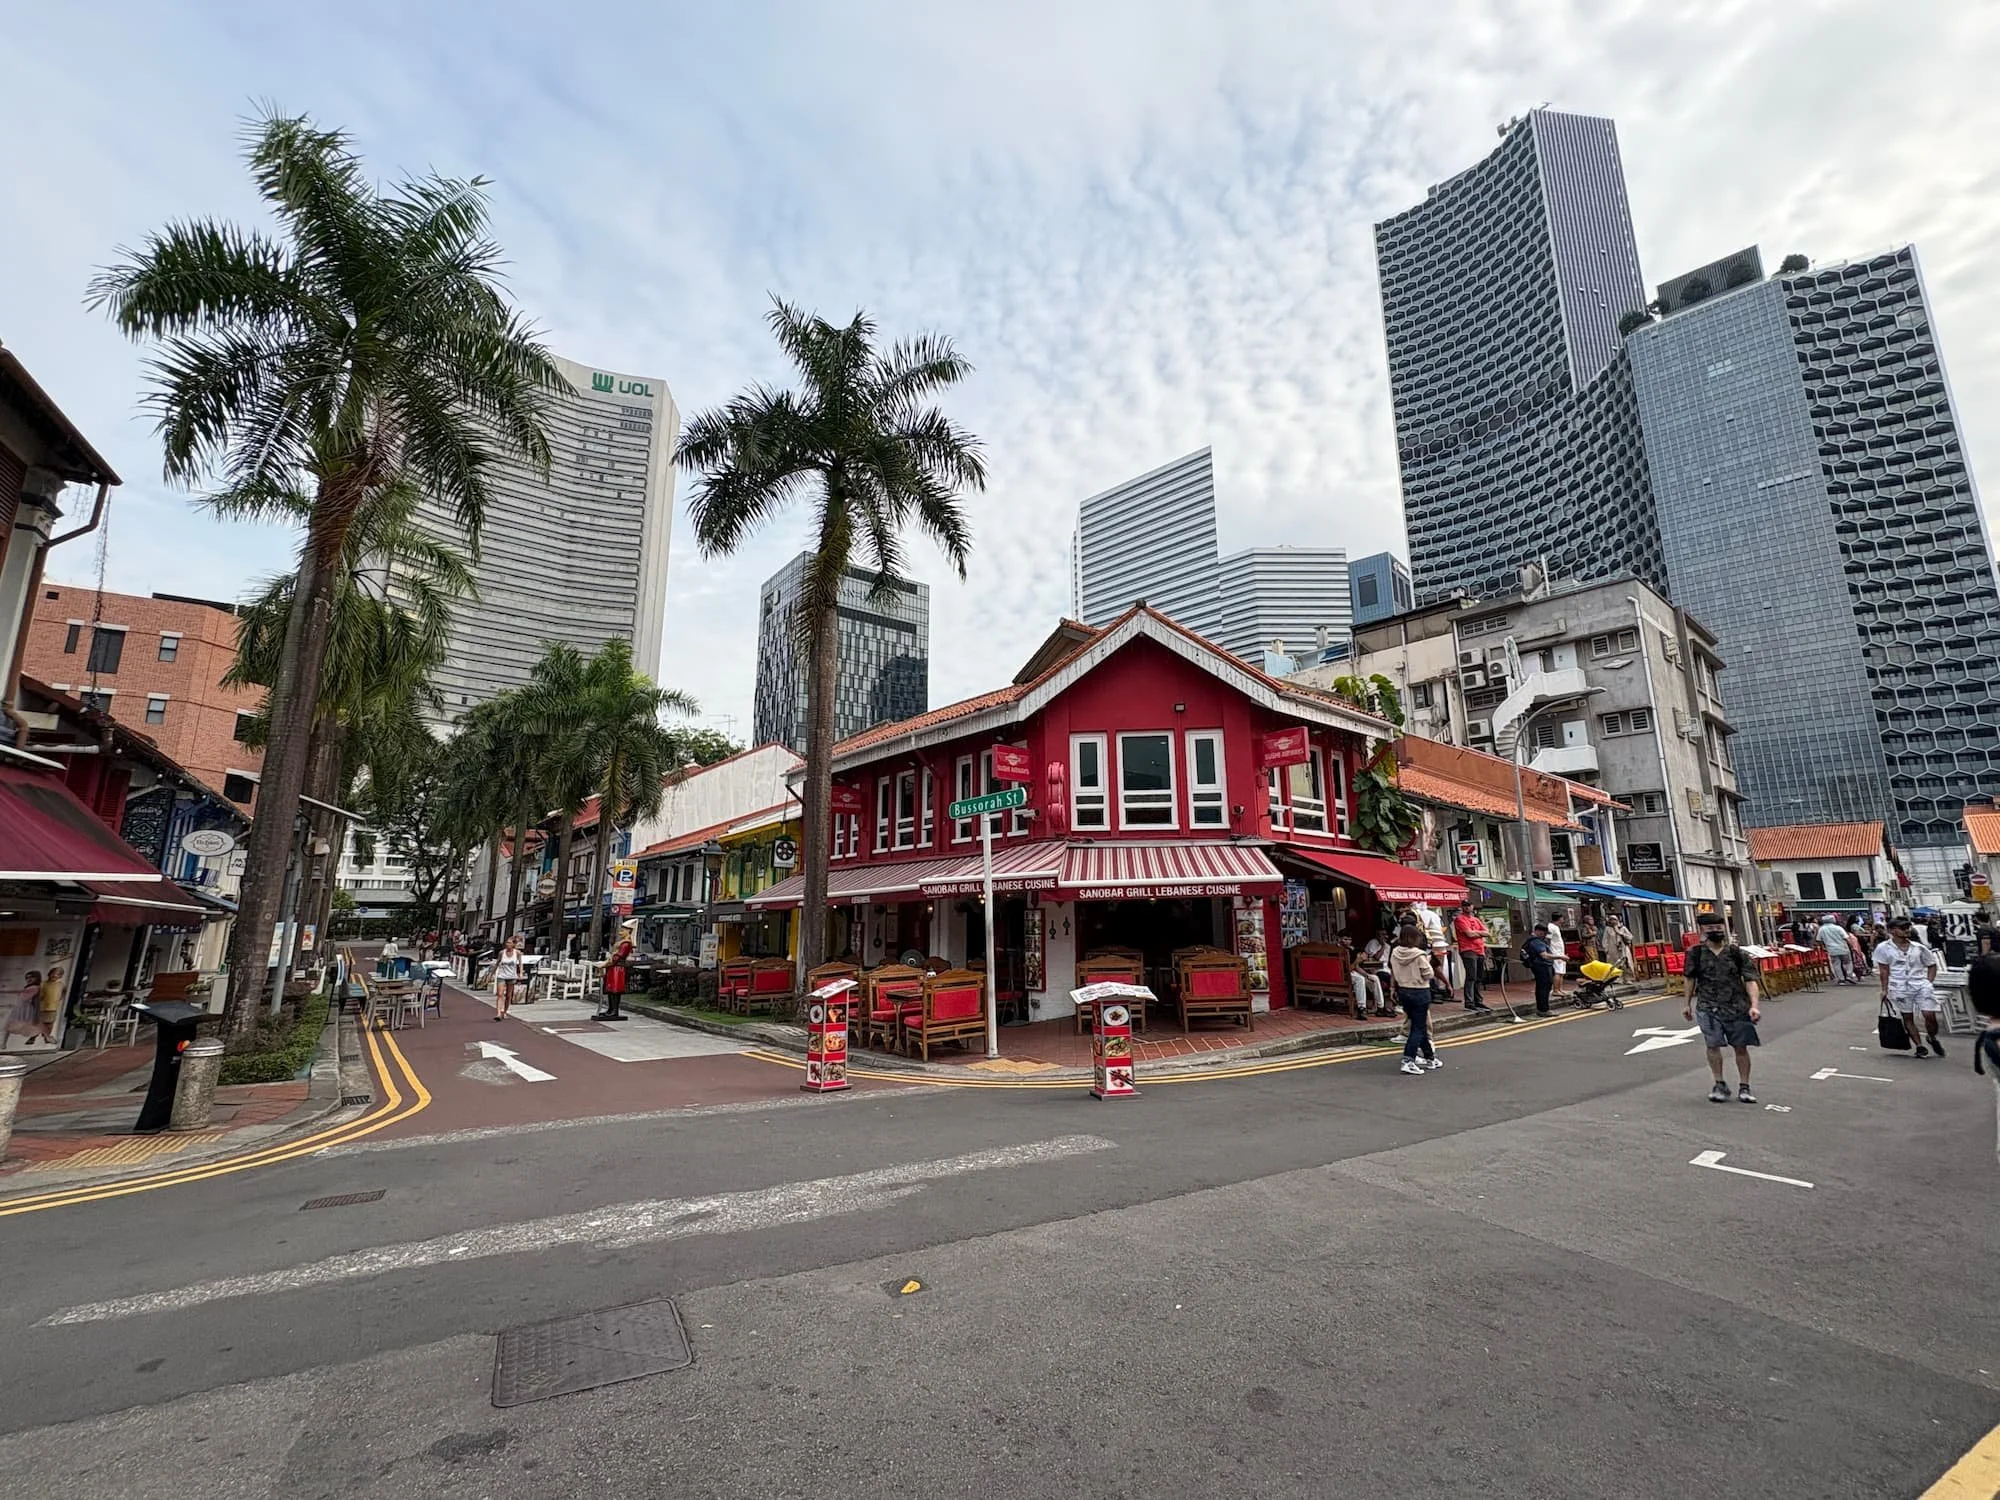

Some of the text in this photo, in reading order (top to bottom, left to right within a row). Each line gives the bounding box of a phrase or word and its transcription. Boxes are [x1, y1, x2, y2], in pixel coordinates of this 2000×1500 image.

[619, 380, 654, 397] UOL
[954, 792, 1018, 816] Bussorah St
[922, 884, 958, 895] SANOBAR
[960, 881, 981, 893] GRILL
[1024, 879, 1056, 890] CUSINE
[1079, 884, 1241, 899] SANOBAR GRILL LEBANESE CUSINE
